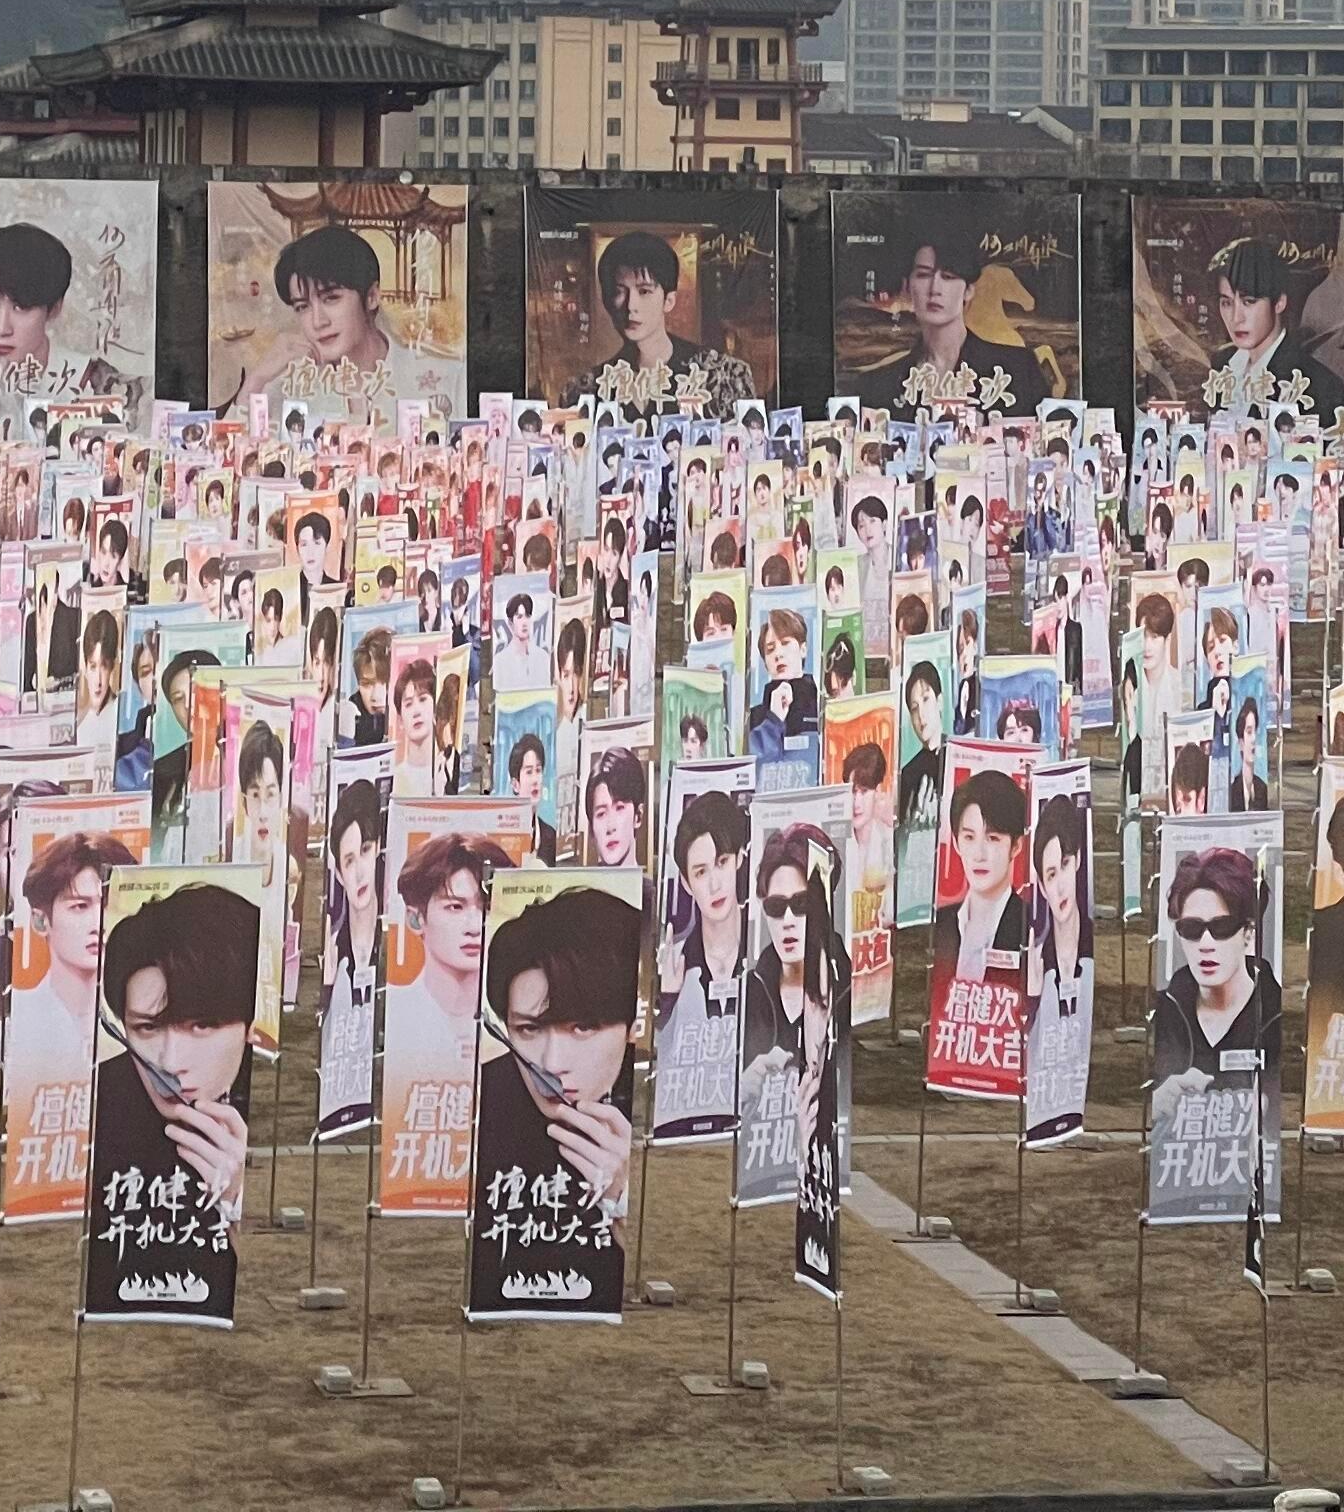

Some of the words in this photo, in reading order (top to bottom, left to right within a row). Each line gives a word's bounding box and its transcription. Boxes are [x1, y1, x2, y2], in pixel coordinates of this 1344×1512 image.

[281, 356, 398, 399] 檀健次
[596, 359, 712, 414] 檀健次
[902, 361, 1016, 411] 檀健次
[1201, 365, 1315, 416] 檀健次
[944, 980, 1019, 1028] 檀健次
[933, 1020, 1022, 1070] 开机大吉
[30, 1084, 91, 1135] 檀健
[404, 1082, 473, 1131] 檀健
[661, 1064, 736, 1109] 开机大
[13, 1135, 89, 1185] 开机
[103, 1165, 231, 1222] 檀健次
[486, 1163, 613, 1222] 檀健次
[97, 1213, 231, 1269] 开机大吉
[481, 1211, 614, 1263] 开机大吉
